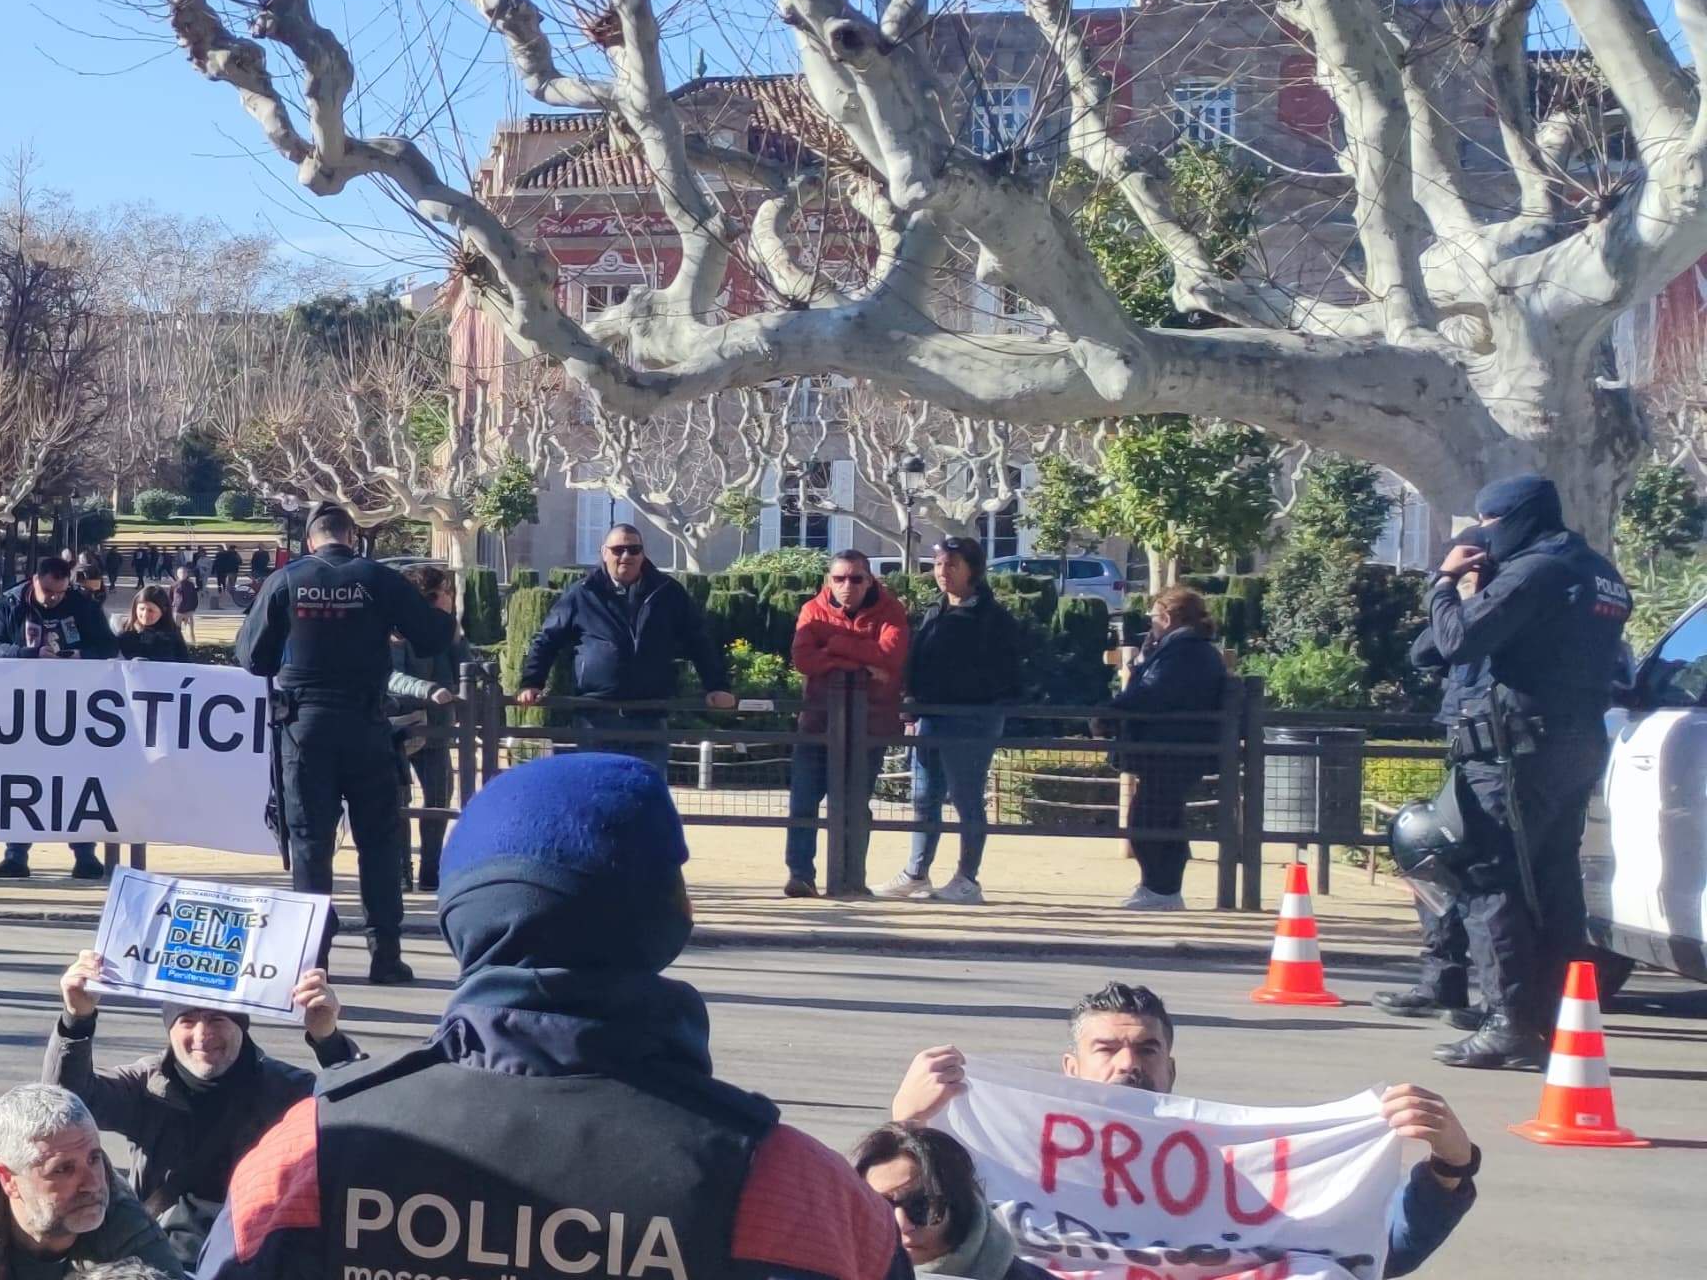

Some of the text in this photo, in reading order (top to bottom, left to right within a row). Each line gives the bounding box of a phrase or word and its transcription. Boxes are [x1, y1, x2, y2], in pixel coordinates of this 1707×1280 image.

[297, 587, 364, 601] POLICIA
[156, 901, 271, 929] AGENTES
[171, 927, 243, 953] DE LA
[123, 944, 278, 980] AUTORIDAD
[1040, 1111, 1292, 1227] PROU
